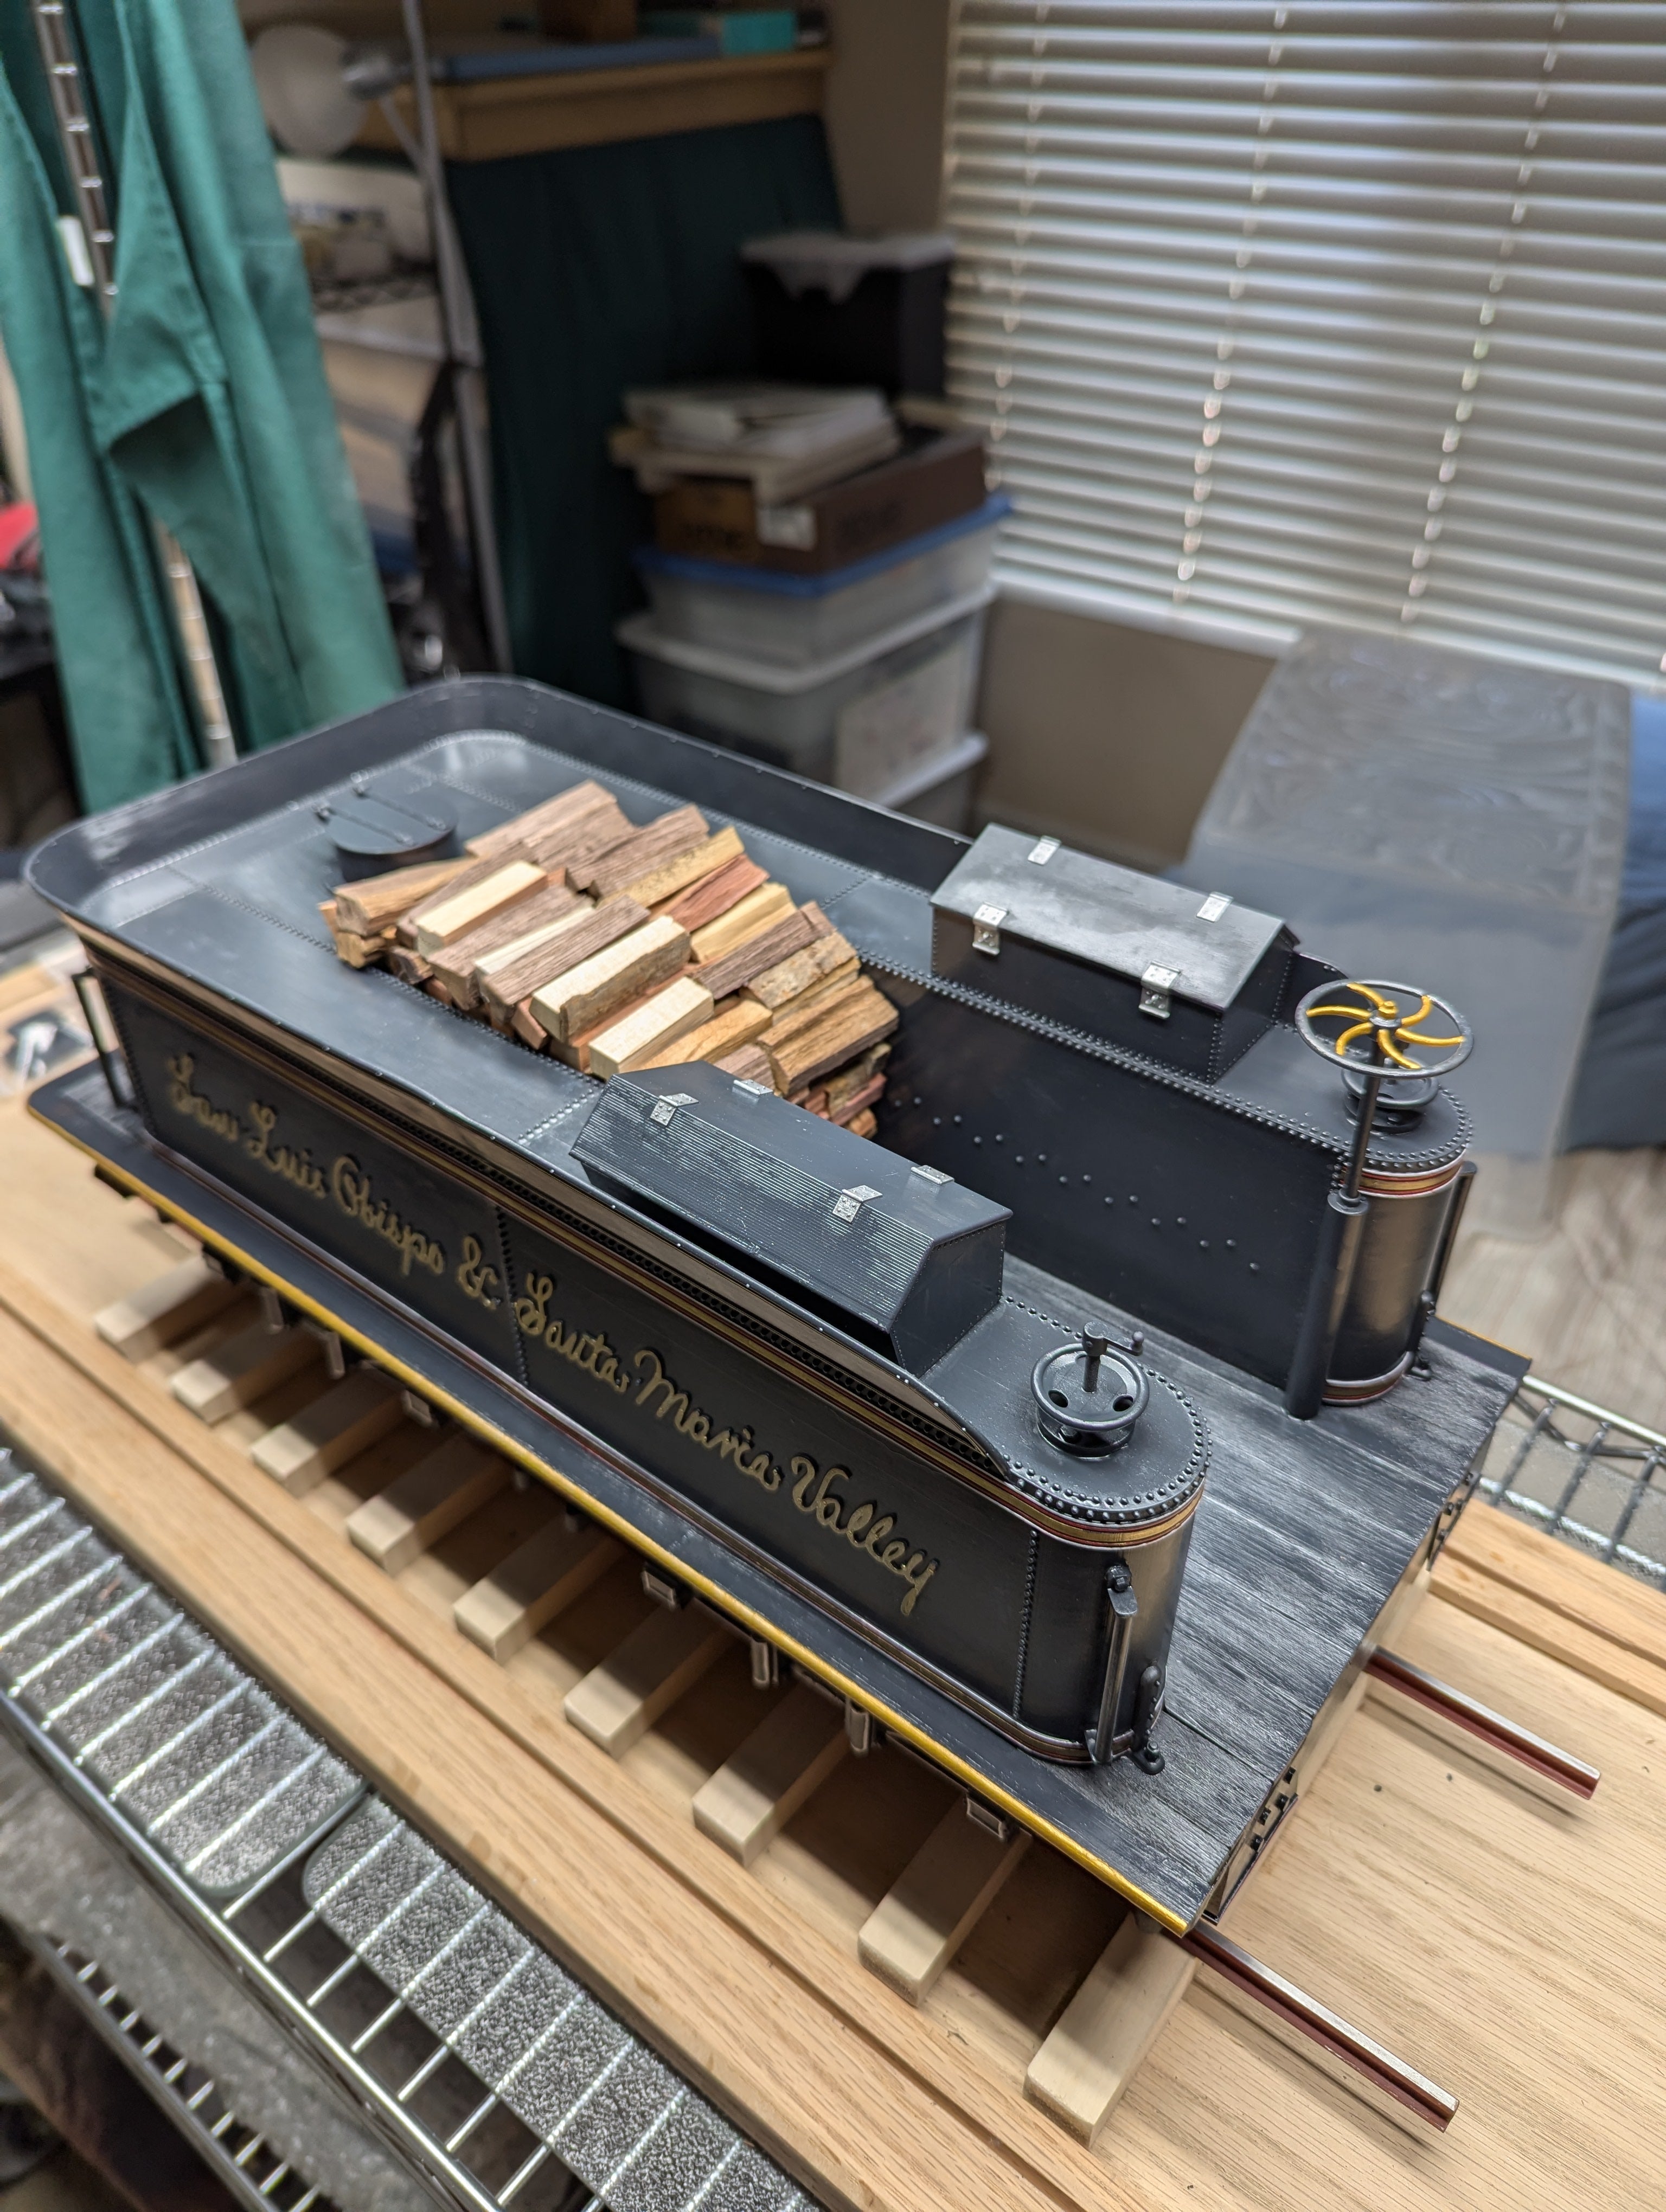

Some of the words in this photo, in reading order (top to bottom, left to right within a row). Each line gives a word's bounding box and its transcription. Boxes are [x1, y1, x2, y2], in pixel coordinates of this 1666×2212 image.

[168, 1054, 239, 1142] San
[246, 1101, 325, 1199] Luis
[332, 1155, 444, 1275] Obispo
[457, 1236, 499, 1310] &
[514, 1271, 630, 1393] Santa
[635, 1349, 783, 1491] Maria
[790, 1455, 940, 1616] Valley
